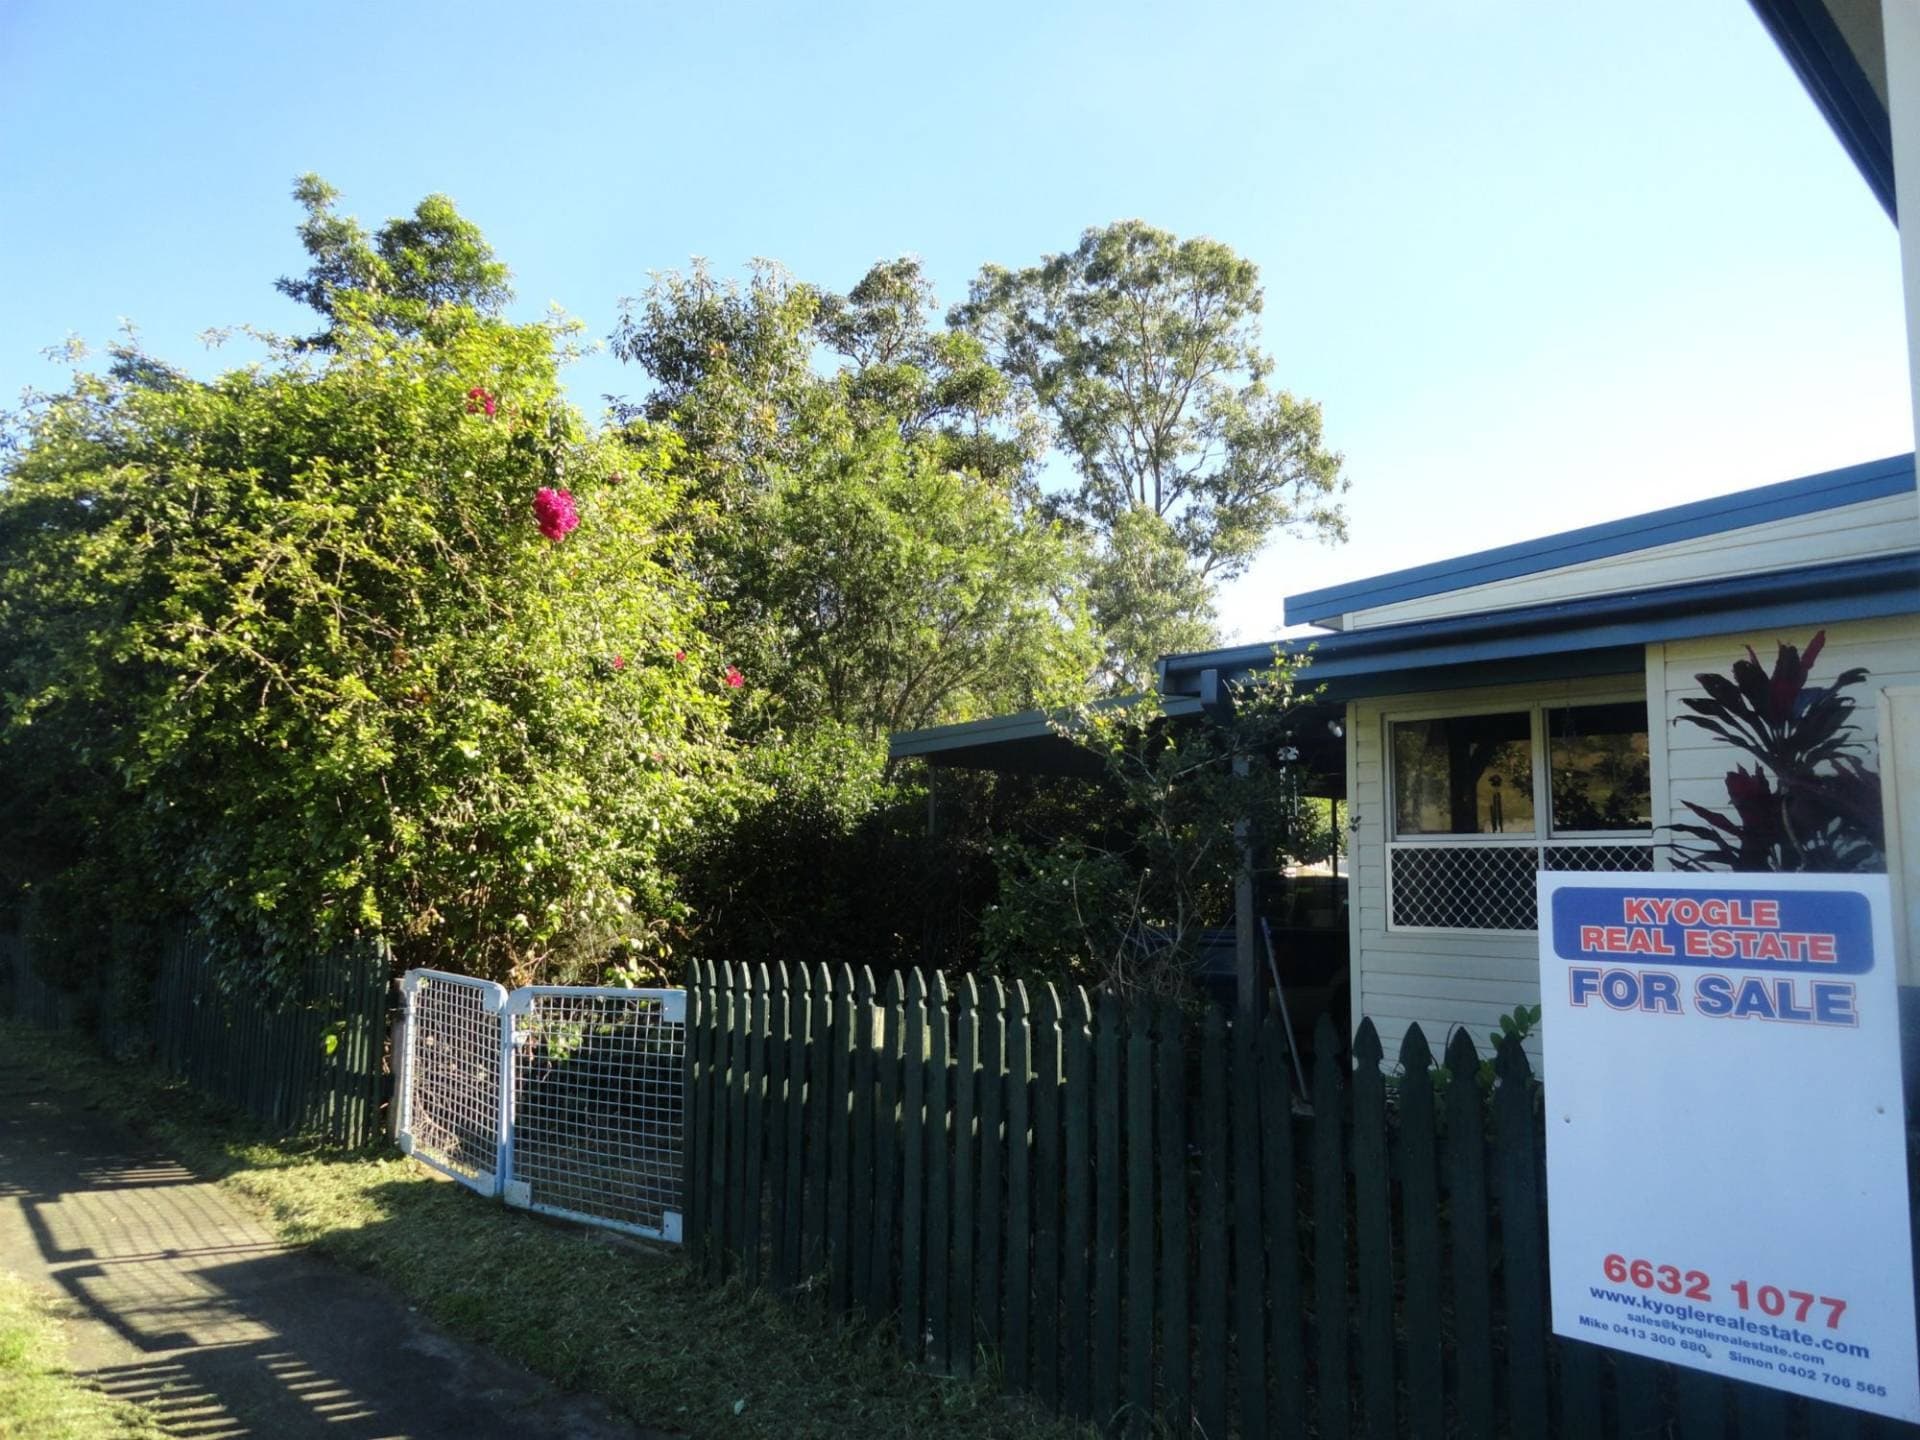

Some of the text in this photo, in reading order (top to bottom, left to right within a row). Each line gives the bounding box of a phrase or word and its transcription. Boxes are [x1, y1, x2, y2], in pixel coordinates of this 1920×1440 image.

[1623, 897, 1780, 929] KYOGLE
[1580, 925, 1838, 963] REAL ESTATE
[1569, 966, 1860, 1028] FOR SALE
[1603, 1253, 1848, 1330] 6632 1077
[1579, 1314, 1609, 1331] Mike
[1613, 1323, 1646, 1340] 0413
[1650, 1332, 1676, 1347] 300
[1589, 1285, 1871, 1360] www.kyoglerealestate.com
[1626, 1312, 1826, 1366] sales@kyoglerealestate.com
[1728, 1350, 1774, 1371] Simon
[1778, 1362, 1817, 1381] 0402
